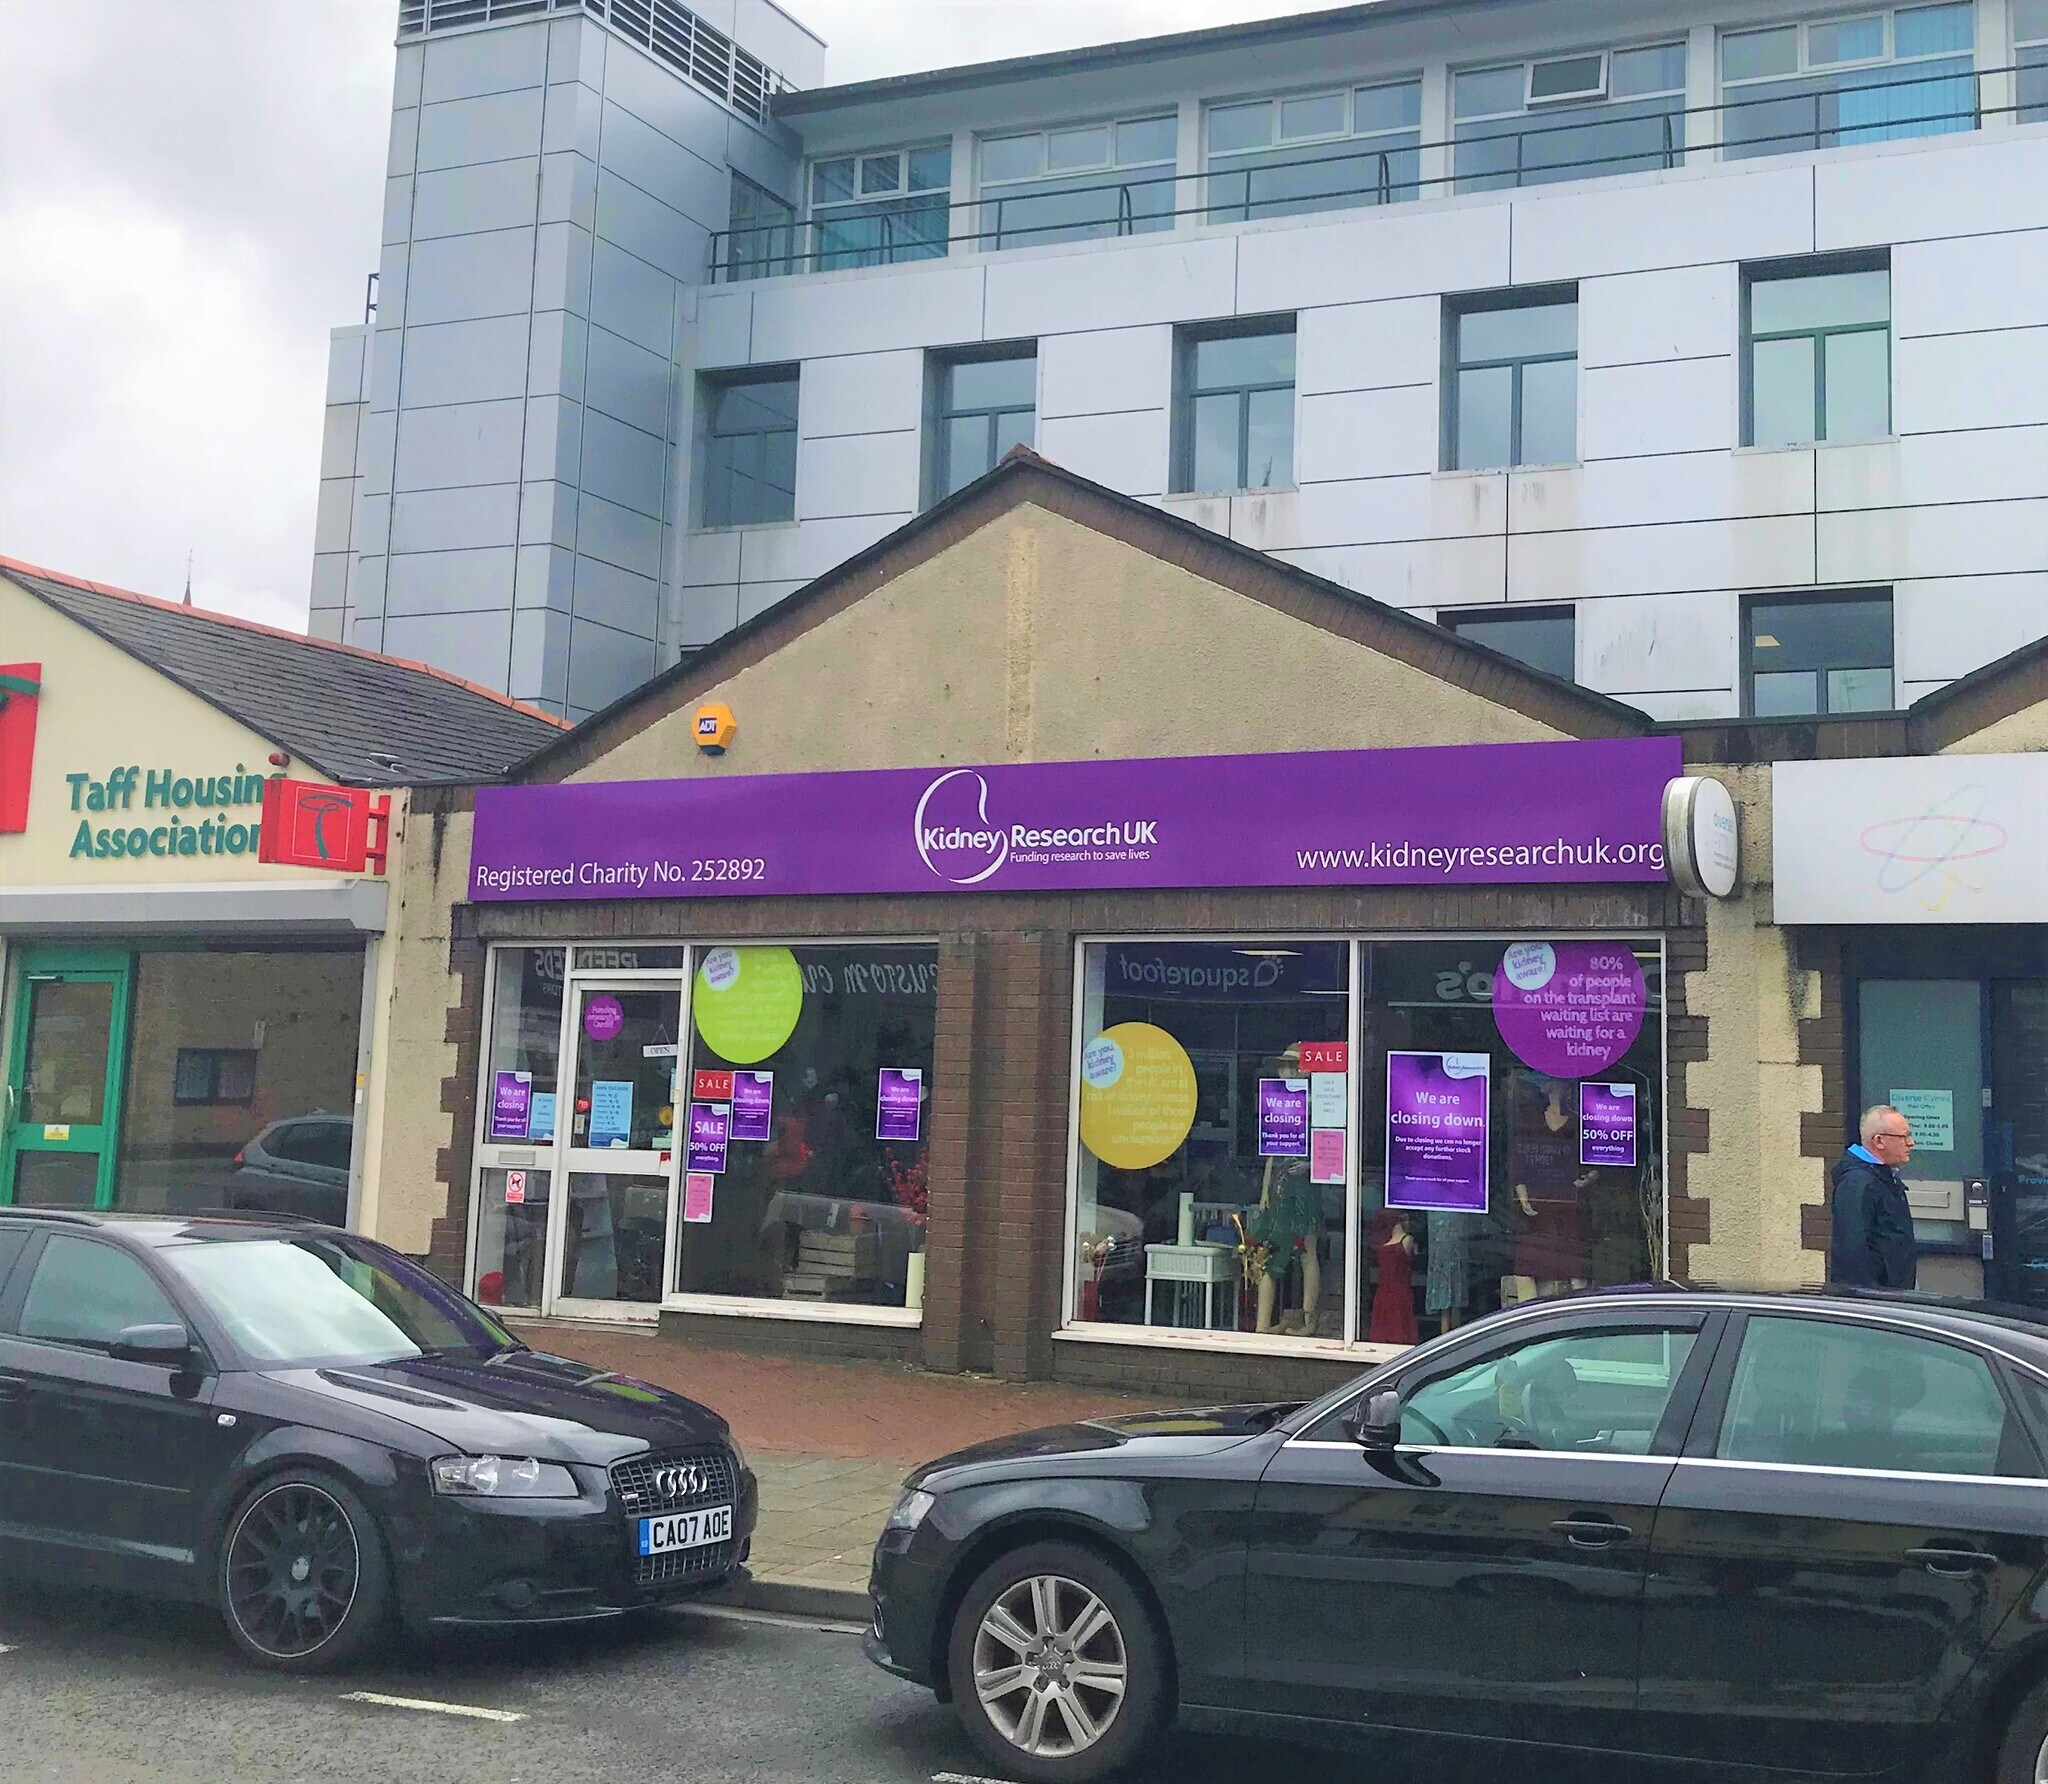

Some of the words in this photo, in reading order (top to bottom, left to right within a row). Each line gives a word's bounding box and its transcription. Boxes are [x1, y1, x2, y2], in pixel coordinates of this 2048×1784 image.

[699, 719, 717, 732] ADT
[66, 766, 139, 811] Taff
[144, 763, 287, 808] Housin
[924, 827, 1001, 854] Kidney
[1010, 851, 1050, 865] Funding
[1051, 850, 1091, 862] research
[1092, 850, 1104, 861] to
[1105, 851, 1127, 860] save
[1128, 849, 1150, 861] lives
[1297, 837, 1665, 873] www.kidneyresearchuk.org
[477, 863, 574, 891] Registered
[579, 861, 649, 888] Charity
[653, 860, 686, 883] No.
[691, 858, 765, 882] 252892
[1525, 941, 1542, 957] you
[1512, 954, 1544, 970] kidney
[1590, 956, 1623, 970] 80%
[1515, 962, 1547, 980] aware?
[1569, 973, 1584, 987] of
[1586, 974, 1632, 990] people
[1524, 993, 1542, 1004] on
[1544, 992, 1565, 1004] the
[1567, 991, 1637, 1008] transplant
[1540, 1009, 1587, 1024] waiting
[1589, 1008, 1610, 1022] list
[1612, 1011, 1633, 1022] are
[1546, 1025, 1593, 1041] waiting
[1595, 1025, 1613, 1039] for
[1616, 1029, 1626, 1039] a
[1098, 1044, 1114, 1058] you
[1305, 1050, 1342, 1062] SALE
[1566, 1042, 1611, 1061] kidney
[1087, 1054, 1114, 1069] kidney
[1089, 1064, 1117, 1079] aware?
[699, 1079, 729, 1089] SALE
[500, 1087, 512, 1096] We
[513, 1089, 526, 1097] are
[1416, 1092, 1436, 1104] We
[1439, 1095, 1460, 1105] are
[1266, 1097, 1282, 1107] We
[1285, 1100, 1301, 1108] are
[1596, 1103, 1607, 1111] We
[1390, 1110, 1440, 1129] closing
[1444, 1112, 1485, 1127] down.
[1582, 1113, 1610, 1123] closing
[1611, 1114, 1632, 1122] down
[694, 1121, 724, 1135] SALE
[1583, 1129, 1608, 1140] 50%
[1610, 1130, 1633, 1140] OFF
[690, 1142, 708, 1151] 50%
[709, 1143, 725, 1152] OFF
[1463, 1139, 1482, 1147] longer
[1592, 1145, 1624, 1153] everything
[654, 1517, 698, 1548] CA07
[703, 1510, 729, 1539] AOE
